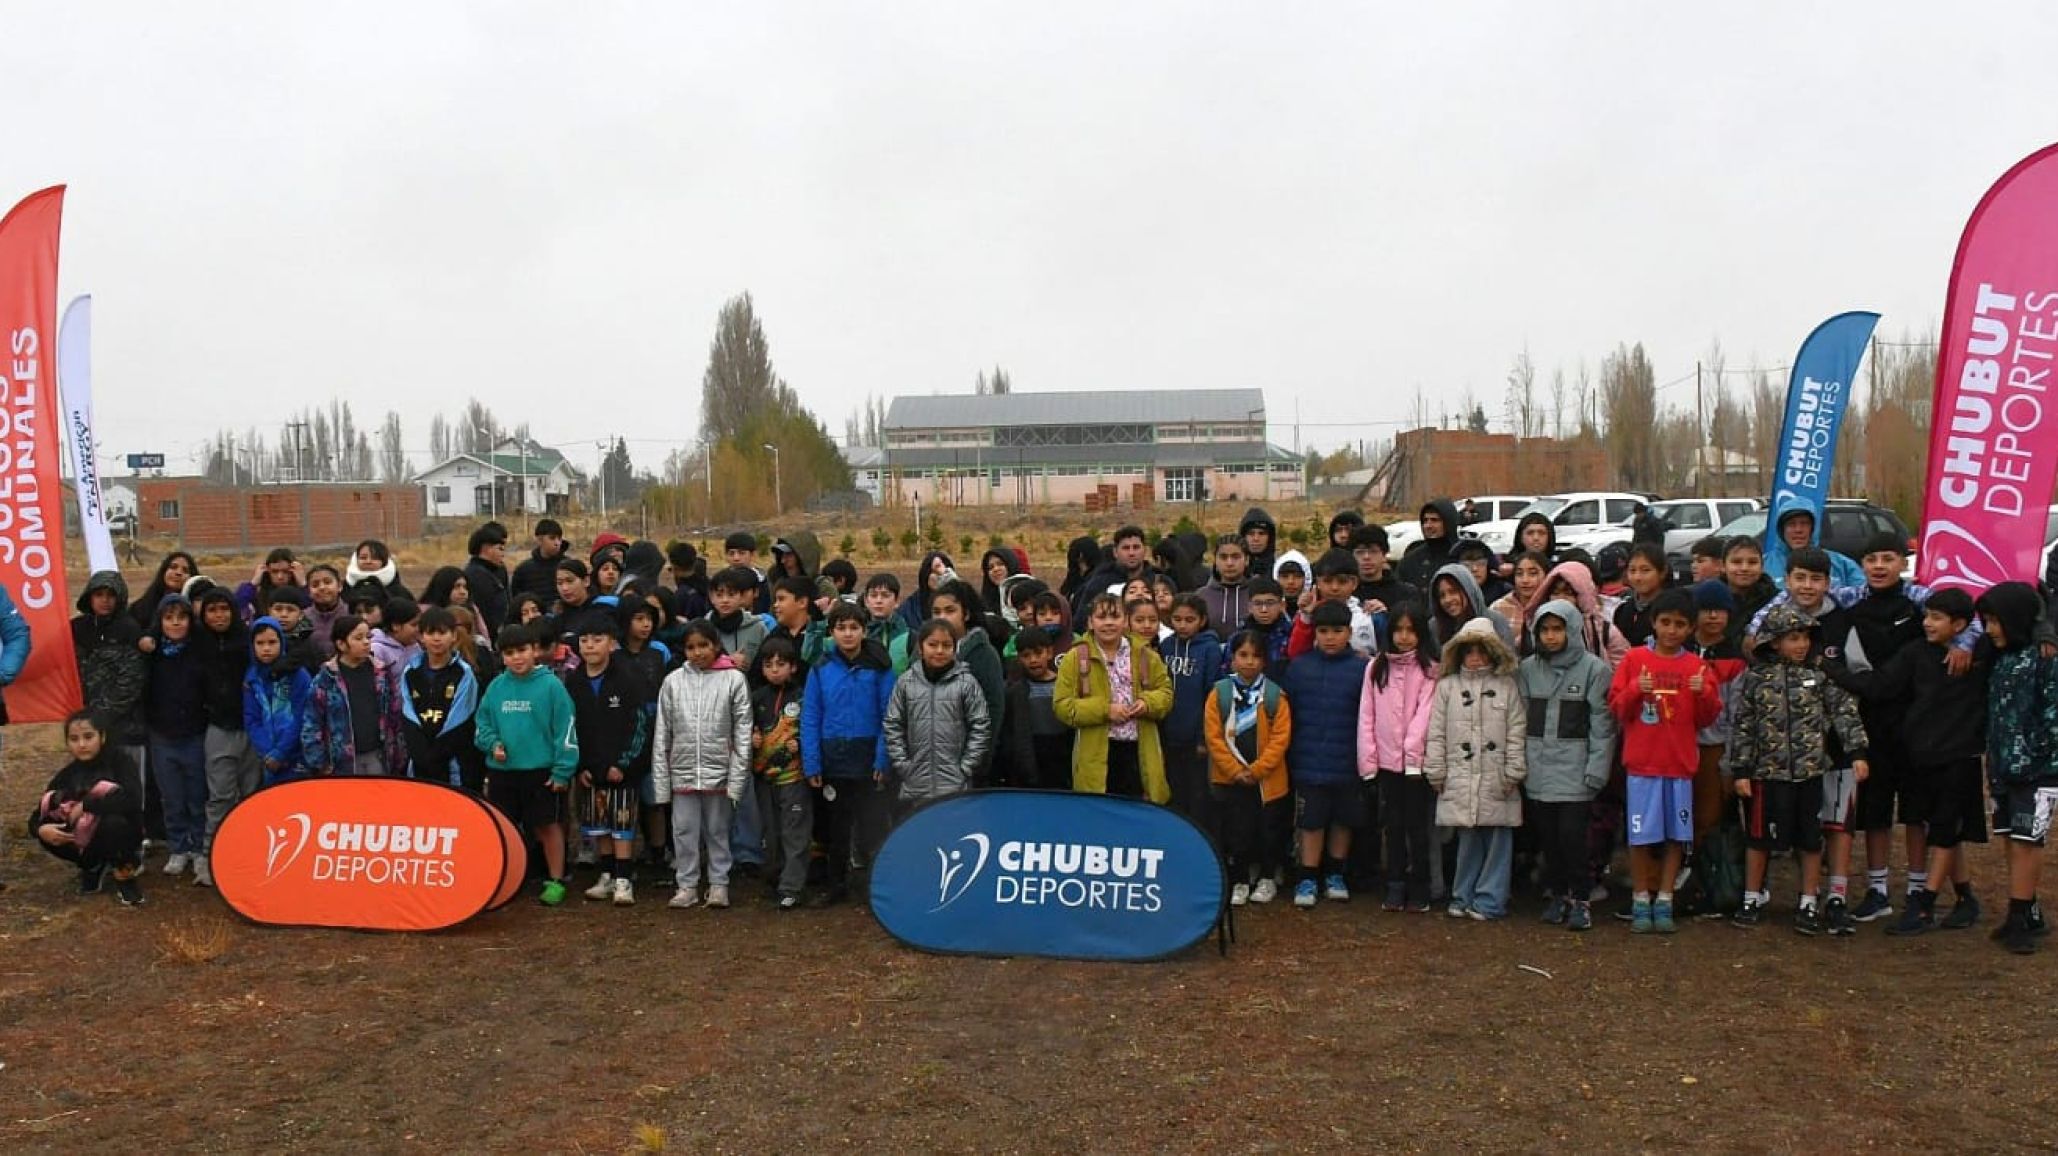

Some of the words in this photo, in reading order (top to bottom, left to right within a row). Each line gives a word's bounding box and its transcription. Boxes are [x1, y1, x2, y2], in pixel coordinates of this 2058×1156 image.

[1785, 377, 1822, 485] CHUBUT
[1802, 382, 1840, 488] DEPORTES
[1939, 283, 2016, 508] CHUBUT
[1983, 291, 2058, 517] DEPORTES
[11, 326, 53, 609] COMUNALES
[313, 854, 455, 887] DEPORTES
[317, 822, 458, 855] CHUBUT
[998, 841, 1163, 878] CHUBUT
[996, 876, 1161, 912] DEPORTES
